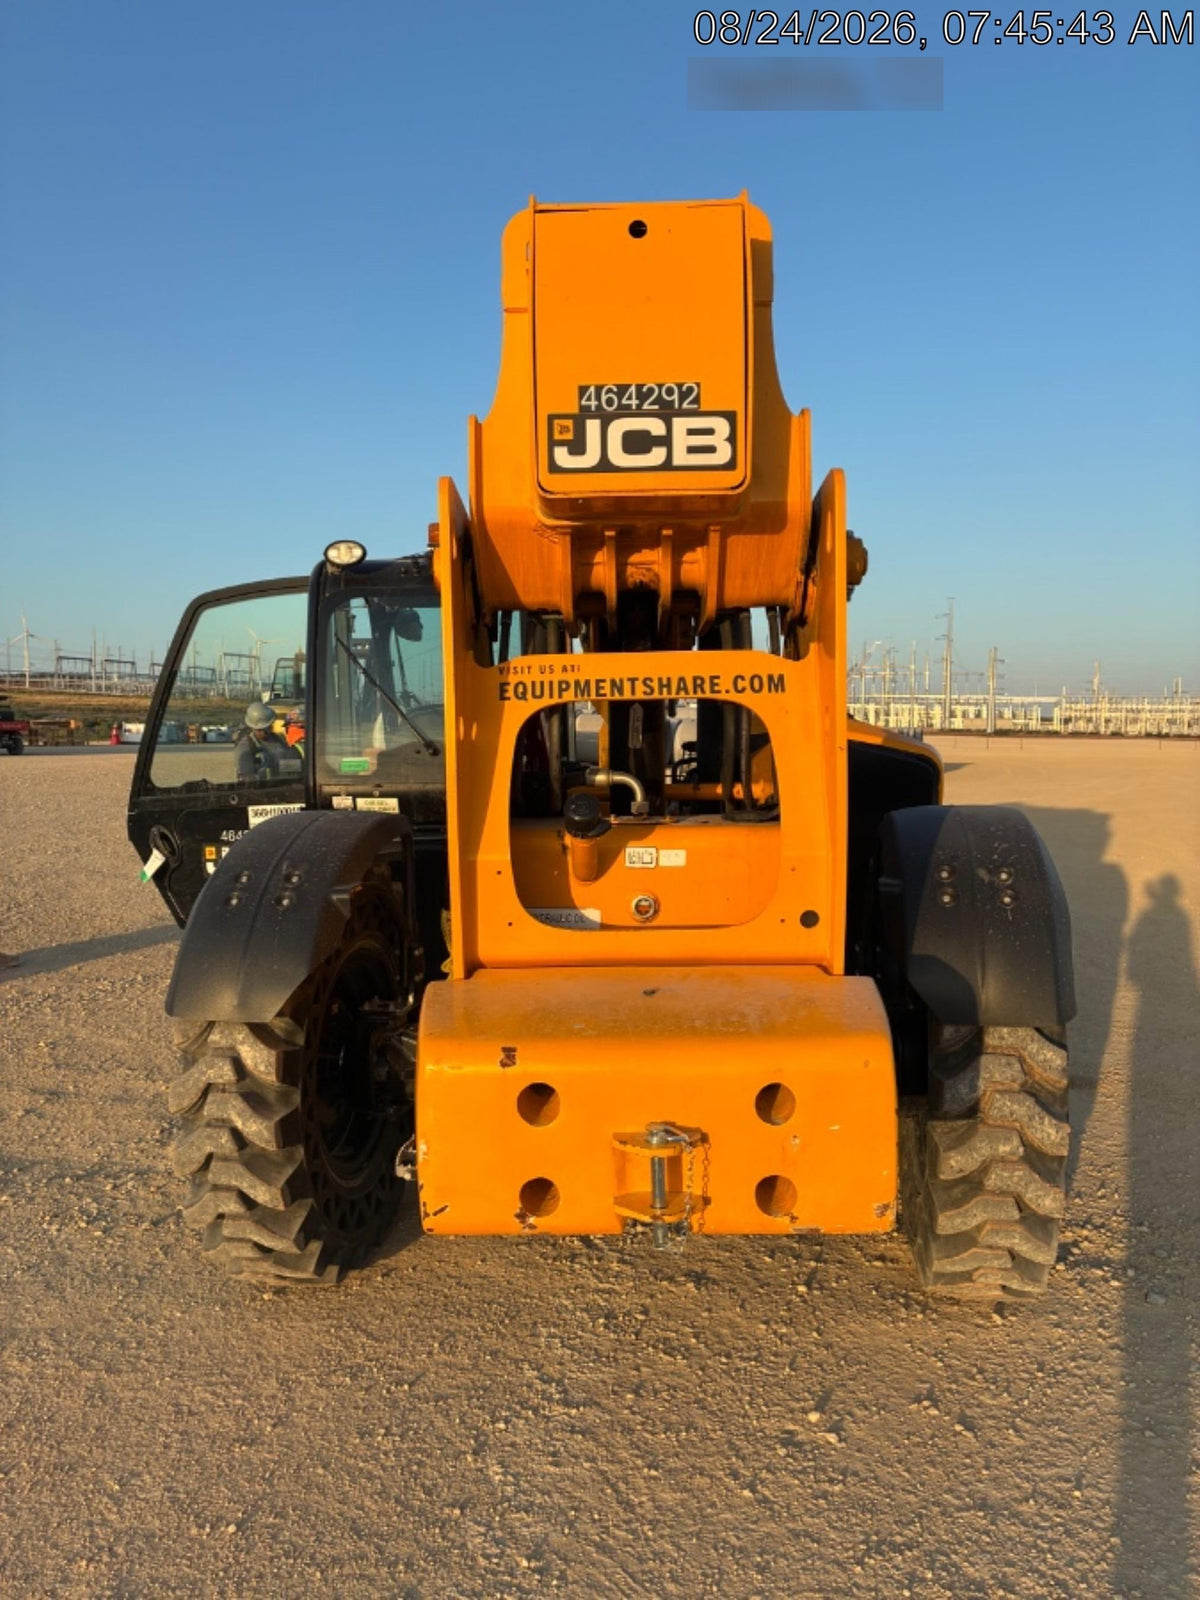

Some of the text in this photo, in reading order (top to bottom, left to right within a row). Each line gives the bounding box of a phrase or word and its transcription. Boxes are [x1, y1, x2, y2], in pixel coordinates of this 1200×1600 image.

[580, 382, 699, 411] 464292
[553, 415, 732, 469] JCB
[498, 665, 531, 675] VISIT
[539, 664, 555, 675] US
[499, 673, 787, 701] EQUIPMENTSHARE.COM
